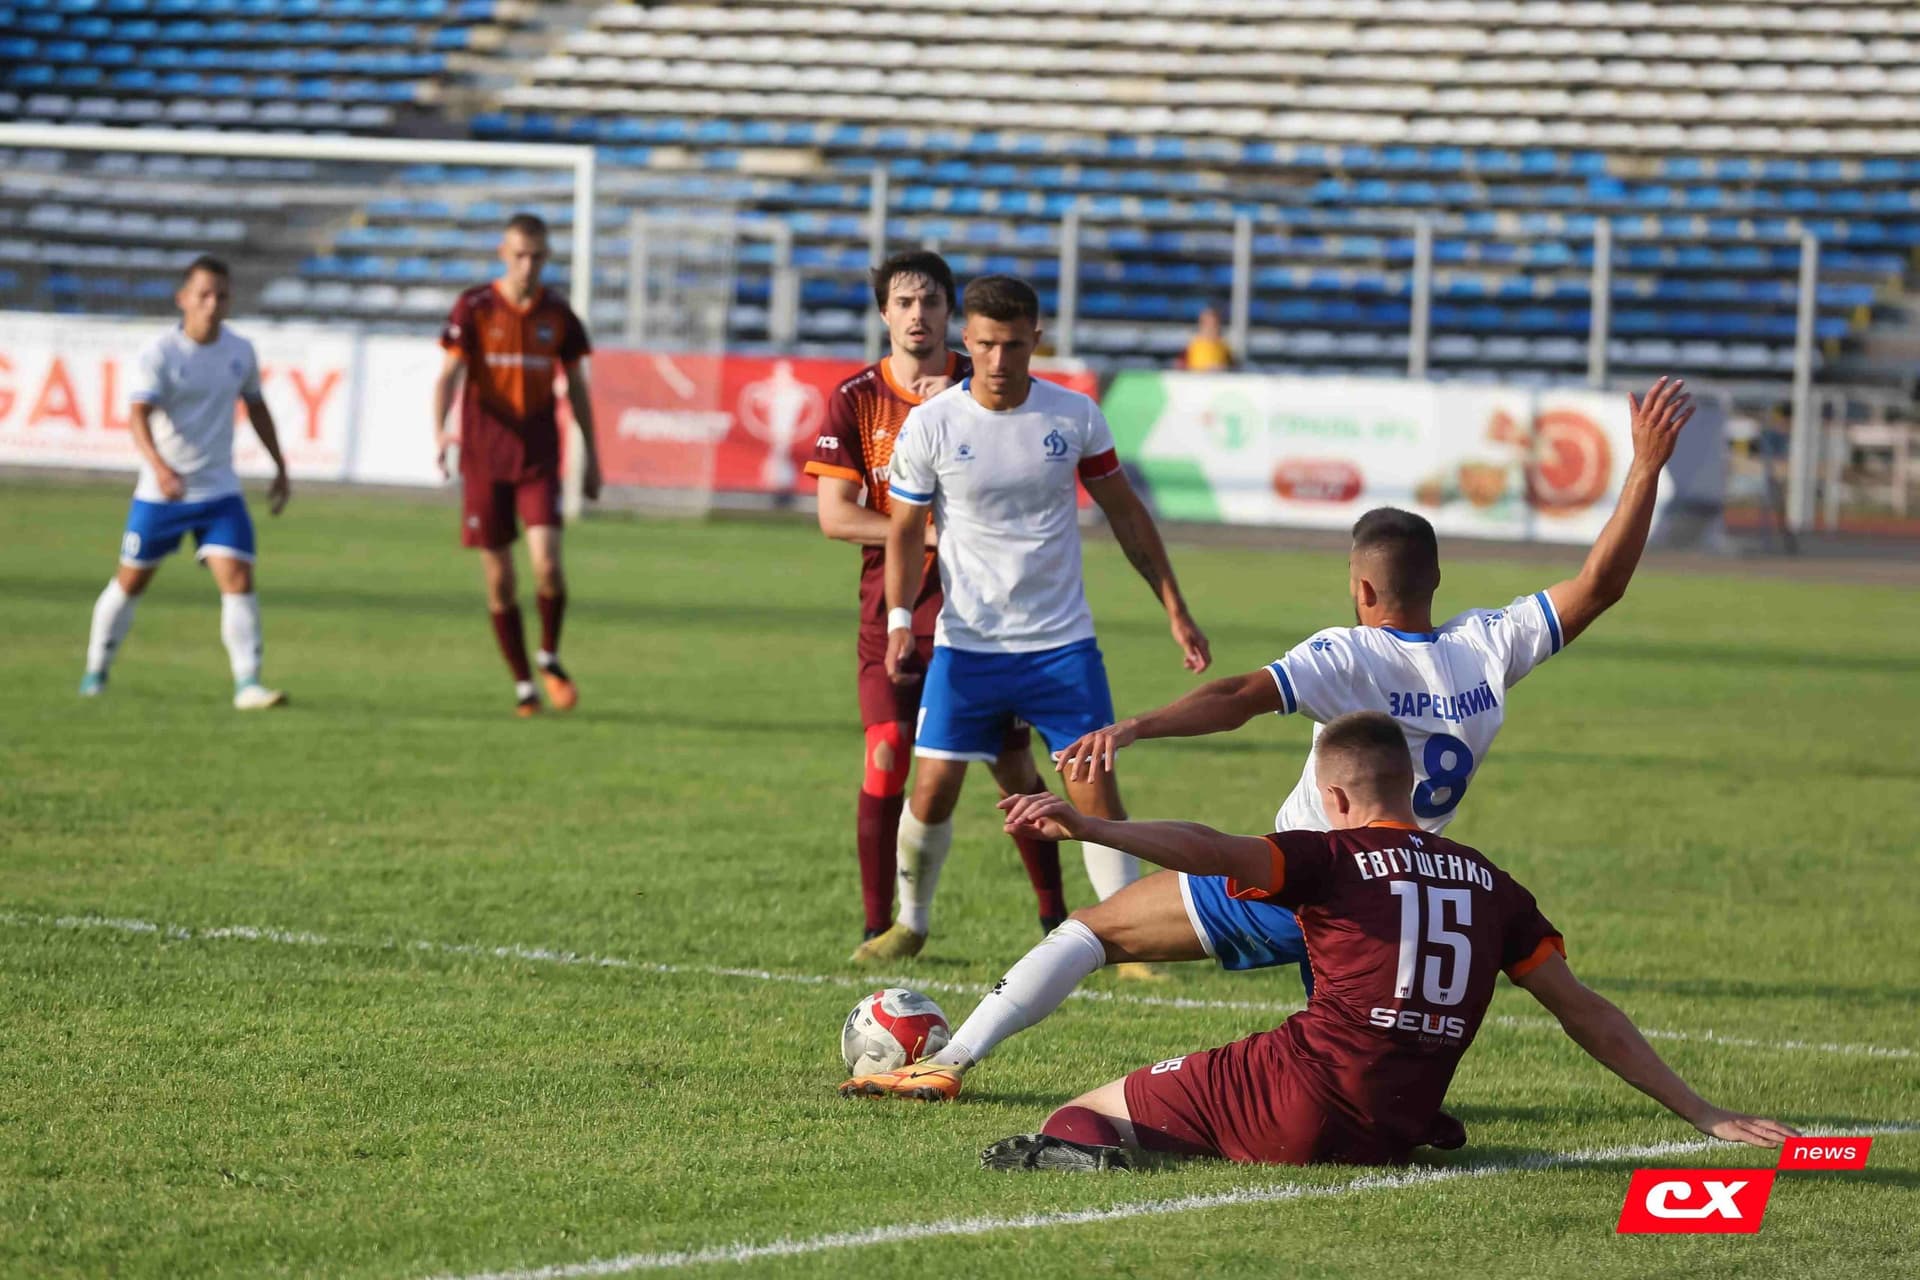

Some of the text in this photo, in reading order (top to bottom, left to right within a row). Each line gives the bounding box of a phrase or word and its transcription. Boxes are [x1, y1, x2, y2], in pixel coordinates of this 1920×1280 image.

[1389, 681, 1498, 724] ЗАРЕЦКИЙ
[1412, 733, 1474, 818] 8
[1354, 847, 1494, 892] ЕВТУШЕНКО
[1390, 880, 1473, 1006] 15
[1369, 1007, 1466, 1039] SEUS
